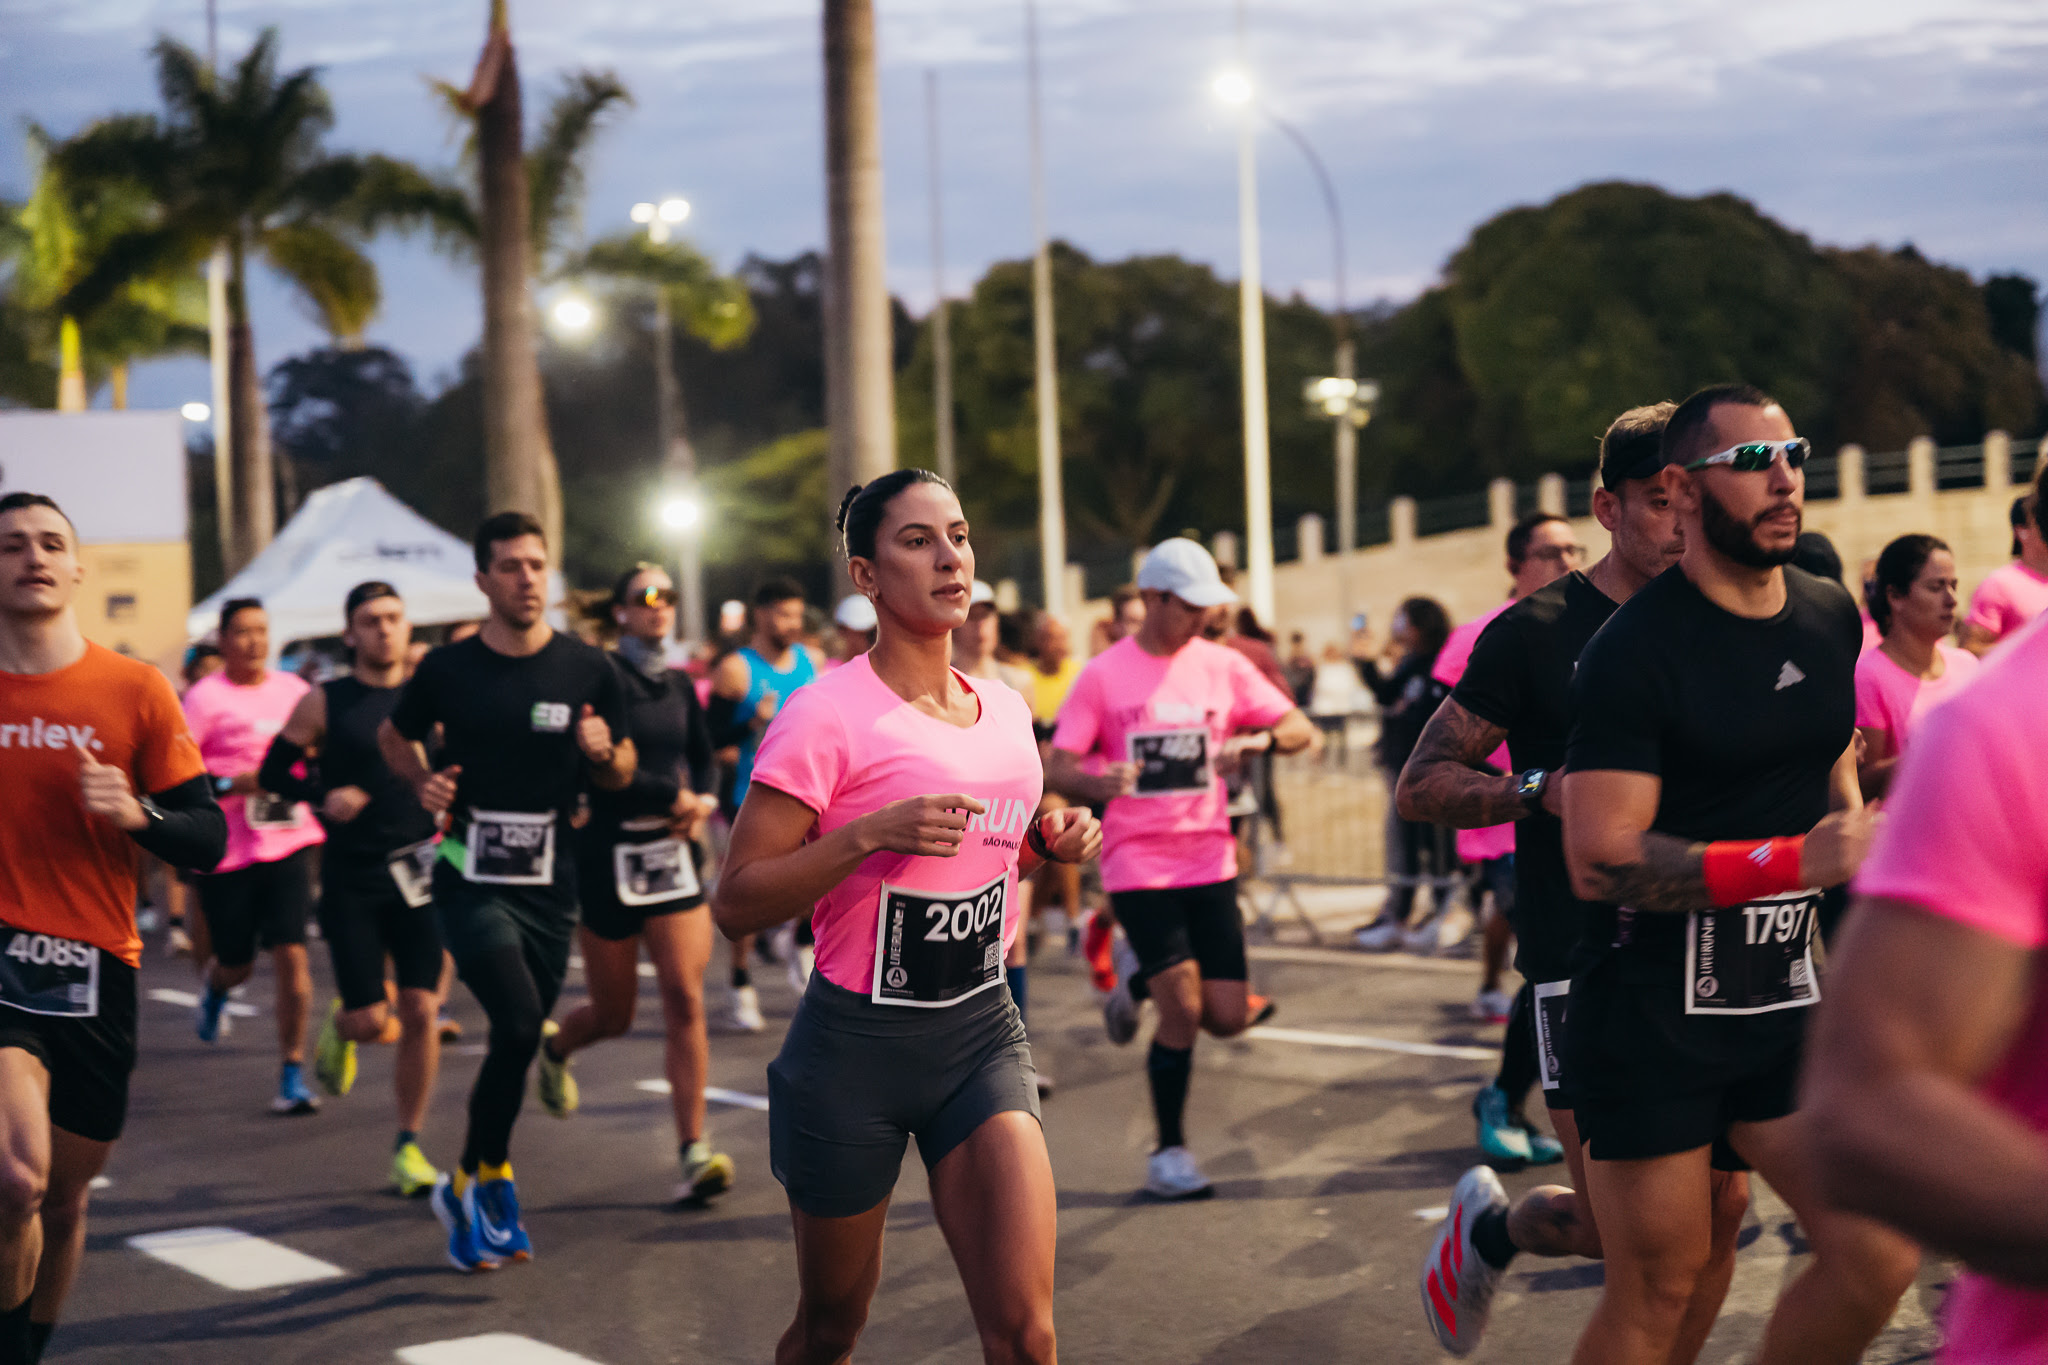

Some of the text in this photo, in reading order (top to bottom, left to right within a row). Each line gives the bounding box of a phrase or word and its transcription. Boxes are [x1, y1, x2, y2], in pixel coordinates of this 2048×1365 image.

[982, 837, 1001, 848] SÃO
[924, 886, 1001, 941] 2002
[1742, 901, 1809, 945] 1797
